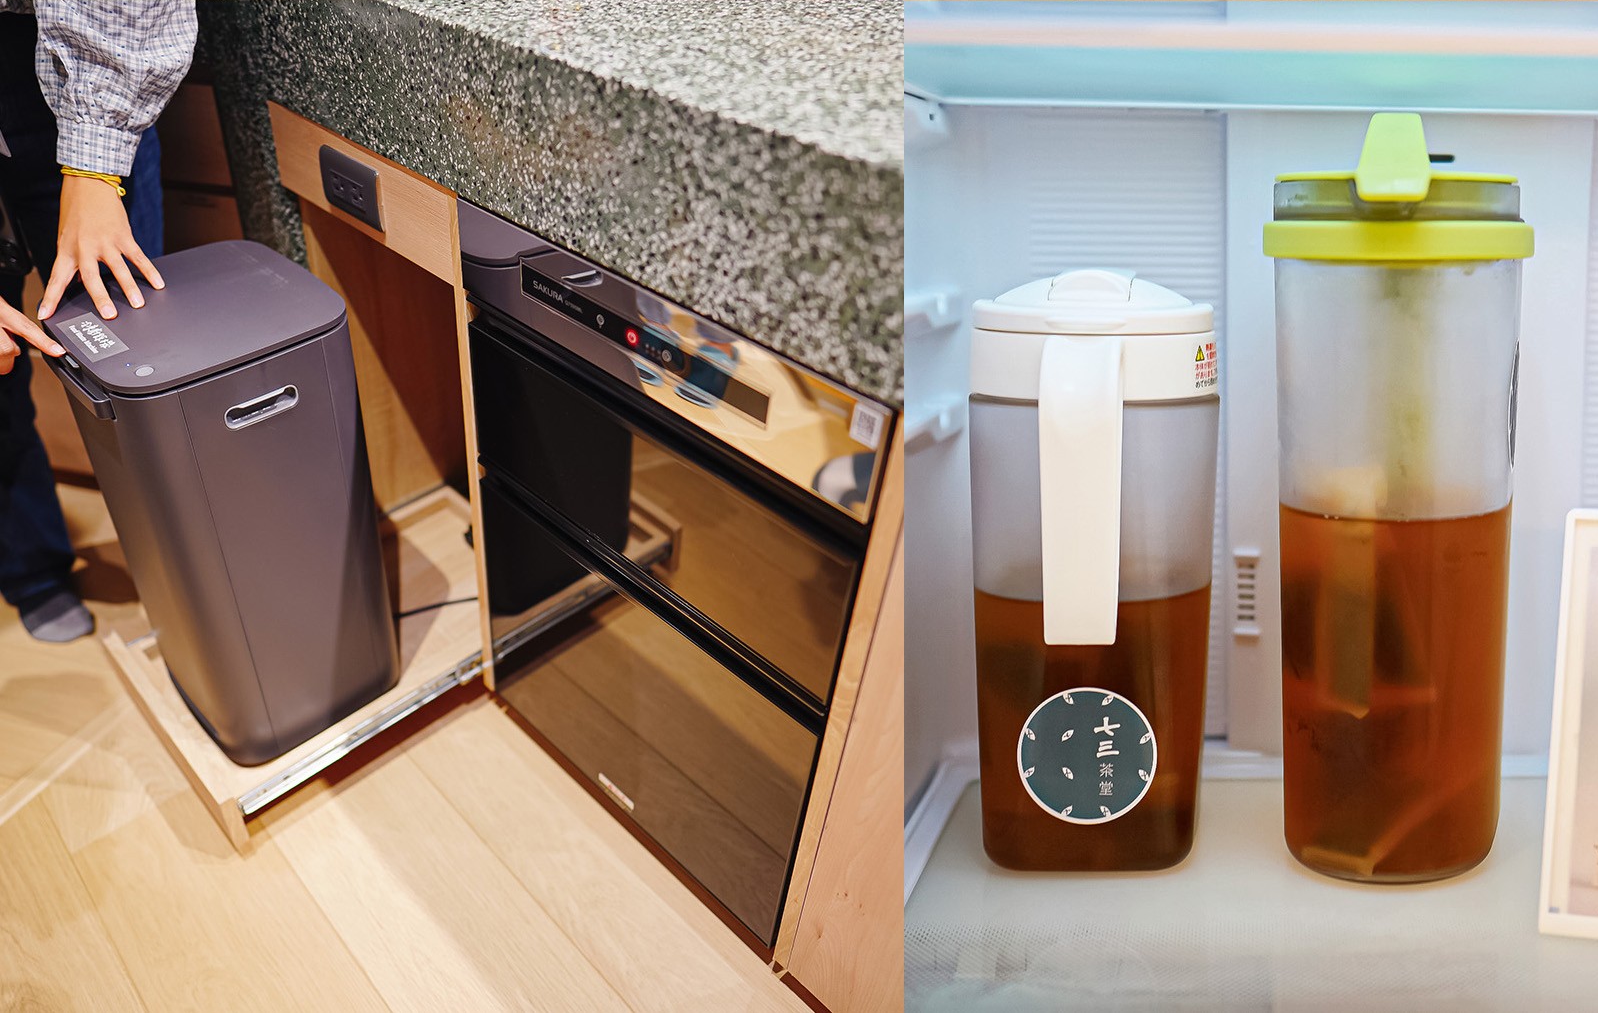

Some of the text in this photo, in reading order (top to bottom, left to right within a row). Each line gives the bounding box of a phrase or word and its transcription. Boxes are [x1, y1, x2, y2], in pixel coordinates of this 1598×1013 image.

[532, 280, 564, 304] SAKURA
[1093, 716, 1121, 796] 七三茶堂
